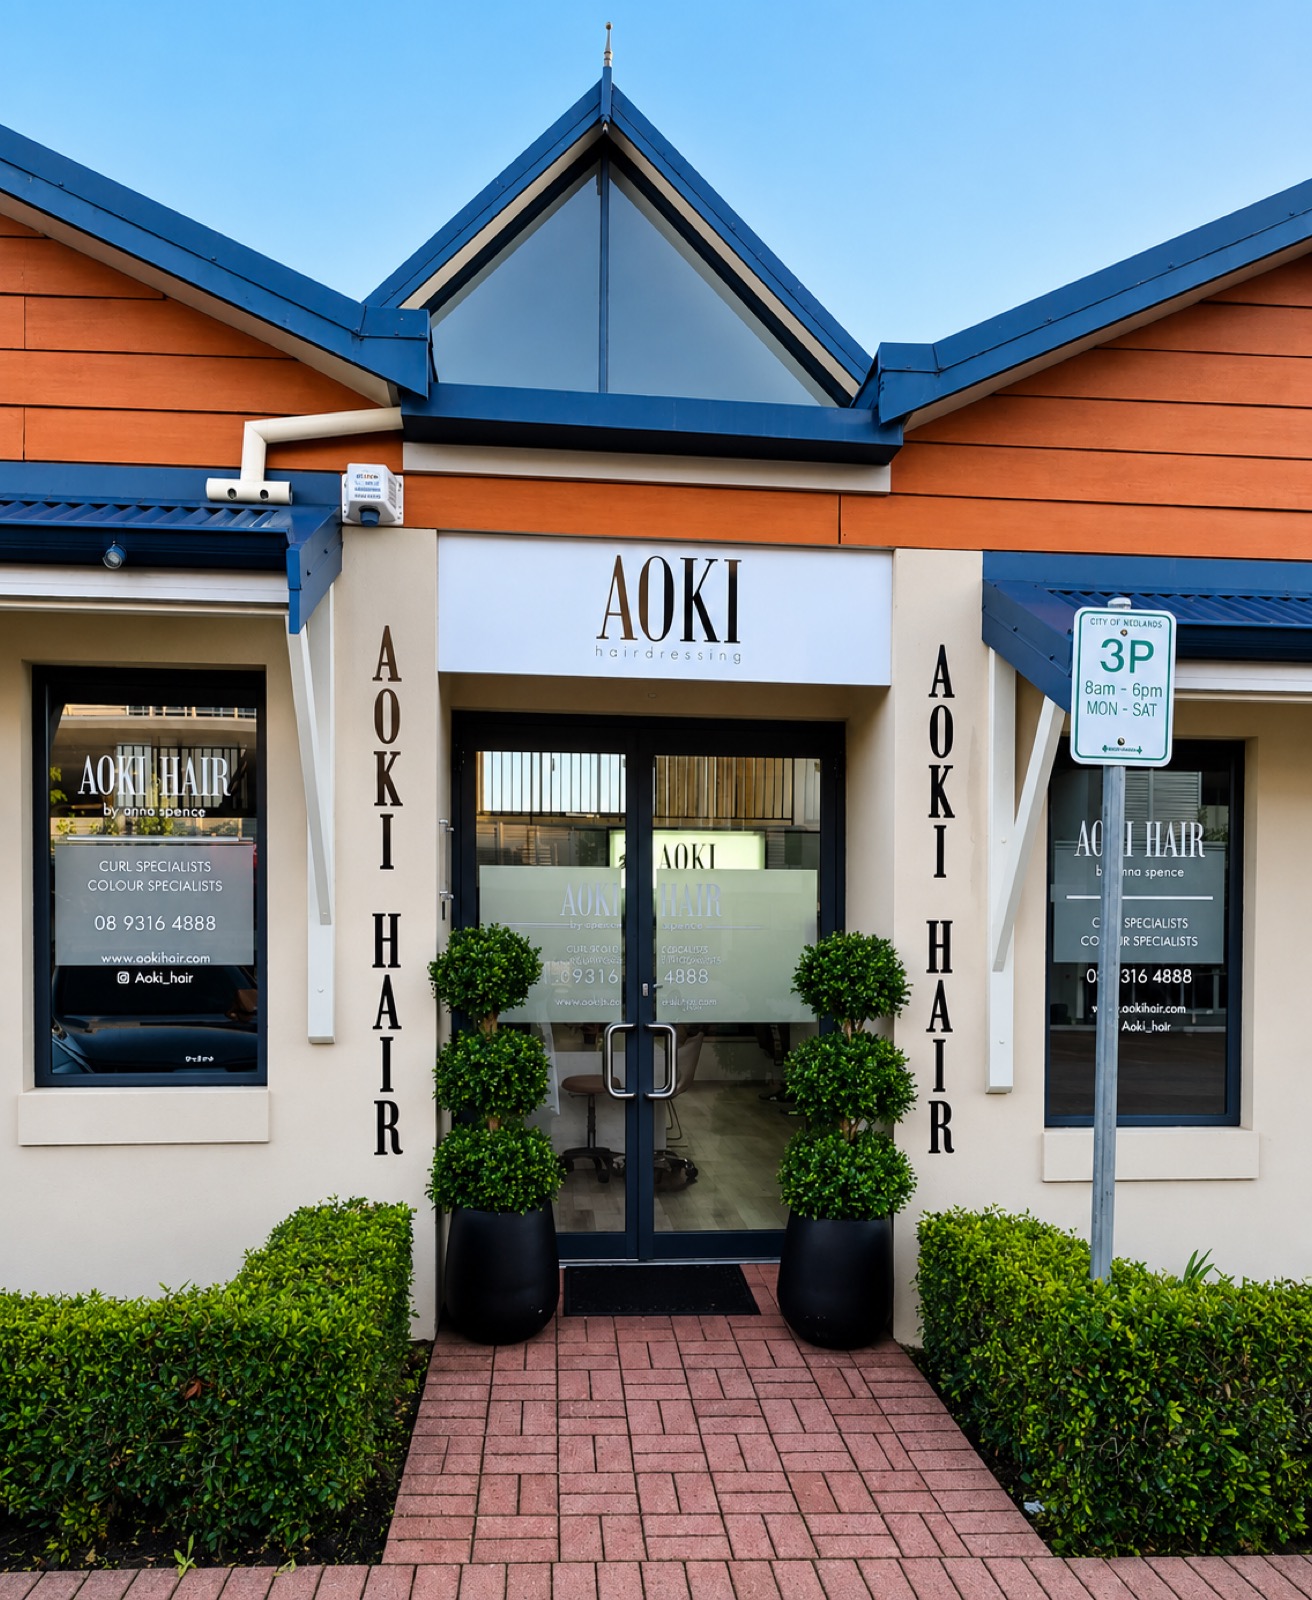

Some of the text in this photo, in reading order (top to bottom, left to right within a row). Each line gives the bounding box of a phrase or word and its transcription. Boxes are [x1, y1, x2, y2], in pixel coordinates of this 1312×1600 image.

[596, 555, 742, 644] AOKI
[1090, 617, 1163, 629] CITY OF NEDLANDS
[595, 645, 742, 665] hairdressing
[1100, 638, 1155, 674] 3P
[1085, 680, 1116, 696] 8am
[1132, 682, 1163, 701] 6pm
[1086, 701, 1118, 716] MON
[1132, 702, 1158, 718] SAT
[77, 755, 232, 797] AOKI HAIR
[103, 802, 206, 820] by anna spence
[1074, 820, 1206, 858] AOI HAIR
[659, 842, 717, 870] AOKI
[99, 860, 212, 873] CURL SPECIALISTS
[1121, 868, 1142, 877] nna
[1145, 868, 1185, 880] spence
[88, 879, 223, 892] COLOUR SPECIALISTS
[372, 625, 403, 1156] AOKI HAIR
[560, 882, 722, 917] AOKI HAIR
[926, 644, 956, 1154] AOKI HAIR
[94, 915, 217, 931] 08 9316 4888
[1124, 917, 1189, 929] SPECIALISTS
[1133, 935, 1199, 947] SPECIALISTS
[664, 968, 709, 984] 4888
[1086, 968, 1193, 984] 0 316 4888
